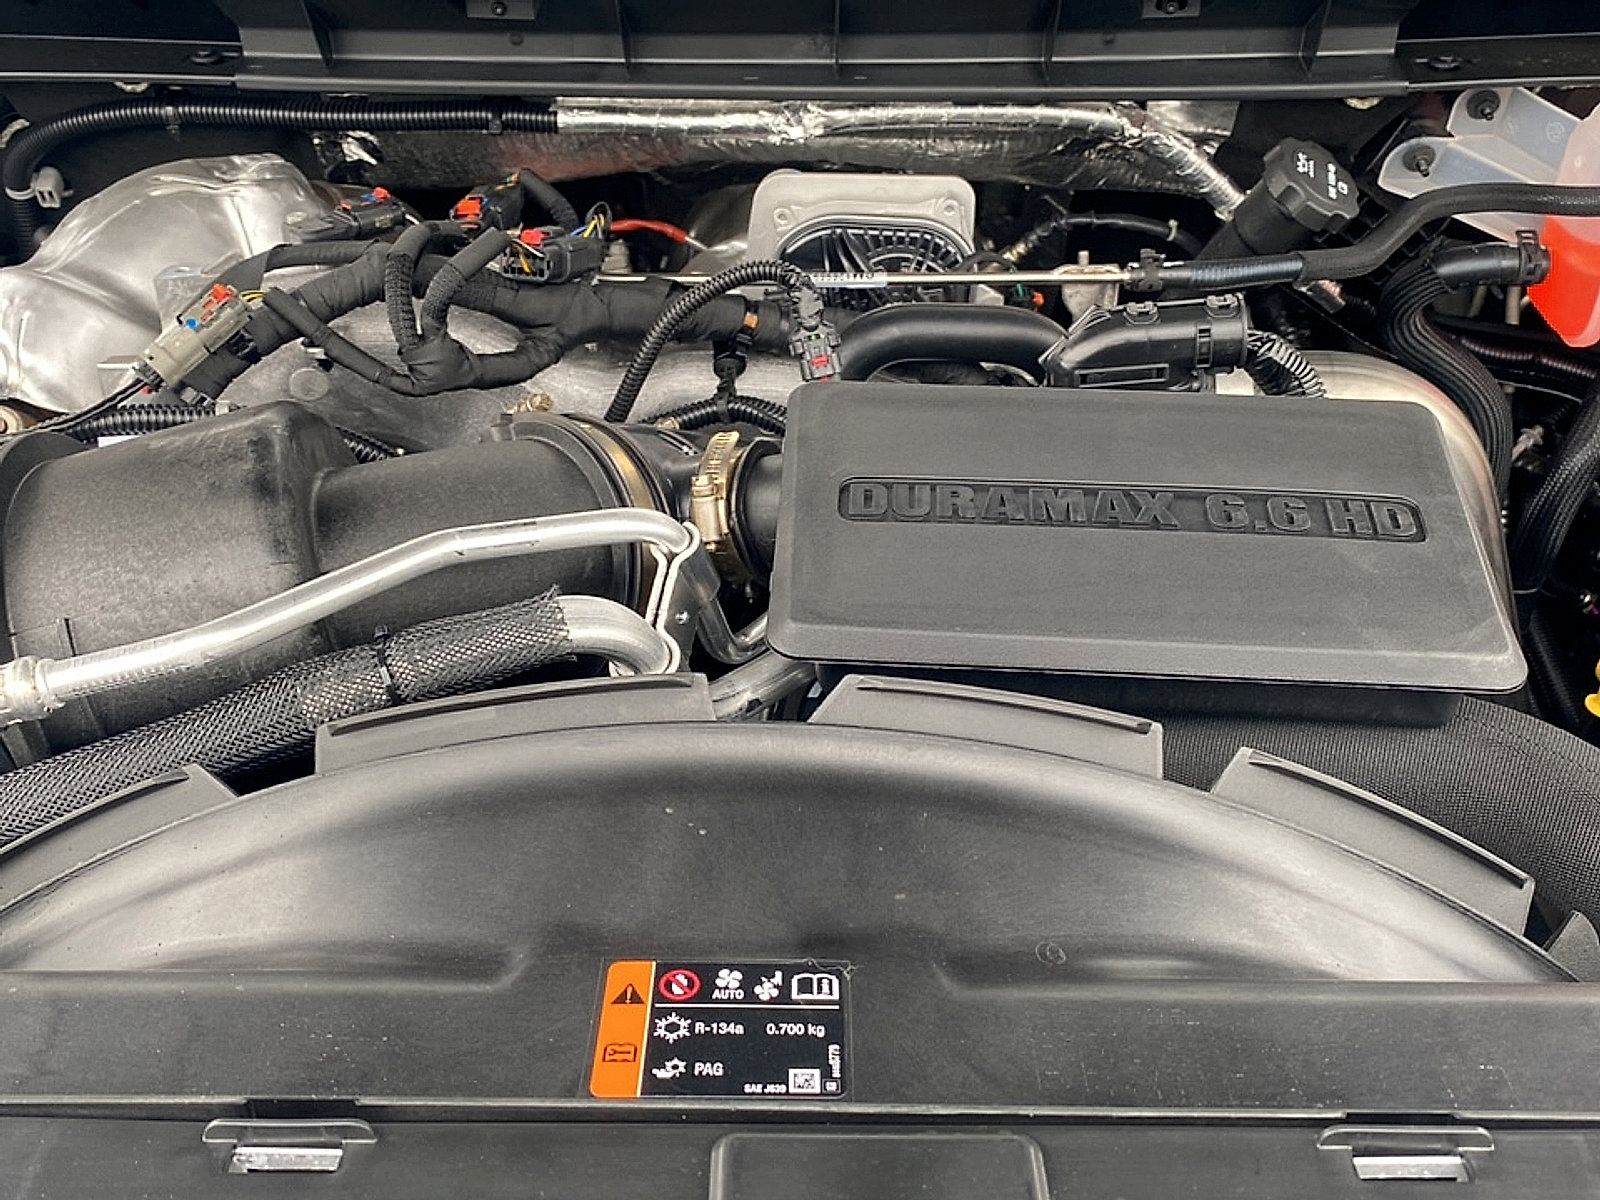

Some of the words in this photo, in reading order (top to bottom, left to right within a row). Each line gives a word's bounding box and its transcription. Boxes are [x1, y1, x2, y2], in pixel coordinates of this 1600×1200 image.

[847, 481, 1181, 530] DURAMAX
[1205, 494, 1312, 533] 6.6
[1324, 499, 1419, 538] HD
[712, 989, 744, 1000] AUTO
[694, 1022, 744, 1035] R-134a
[766, 1023, 804, 1035] 0.700
[807, 1022, 825, 1038] kg
[694, 1063, 724, 1077] PAG
